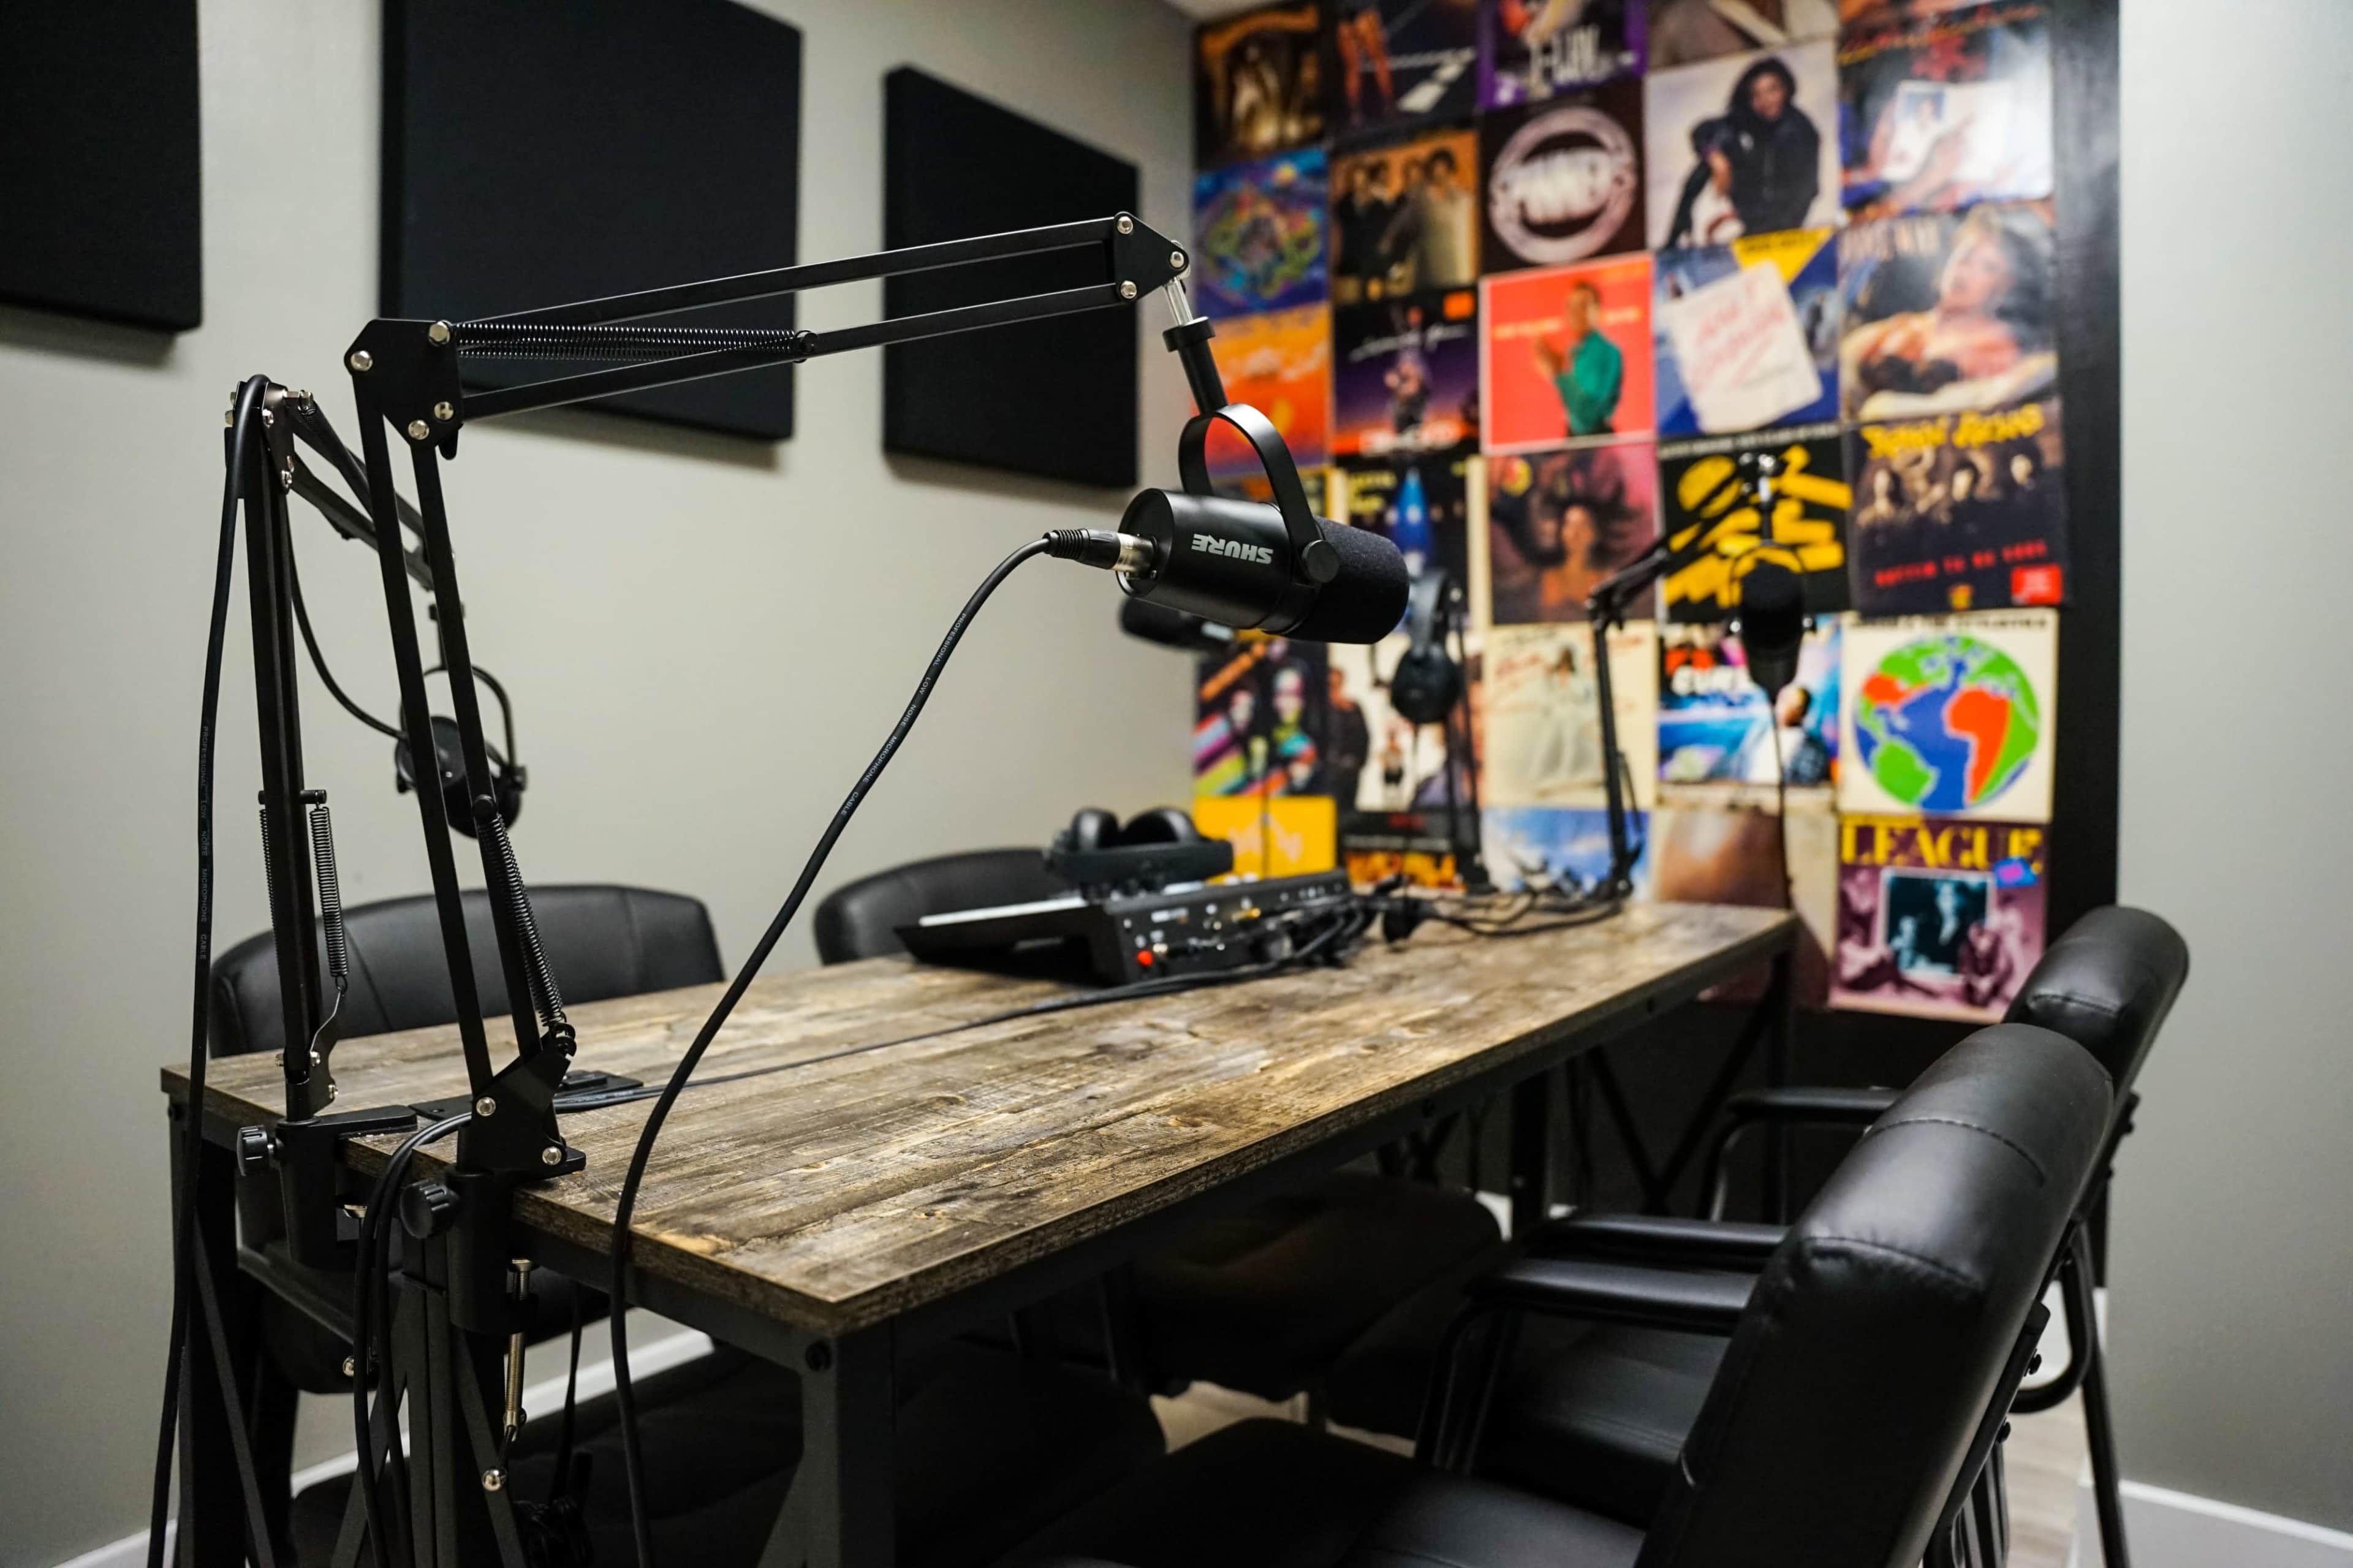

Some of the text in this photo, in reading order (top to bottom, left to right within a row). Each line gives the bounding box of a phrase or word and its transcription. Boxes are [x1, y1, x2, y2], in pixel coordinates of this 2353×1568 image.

[1191, 534, 1274, 564] SHURE
[841, 613, 966, 816] PROFESSIONAL LOW NOISE MICROPHONE CABLE
